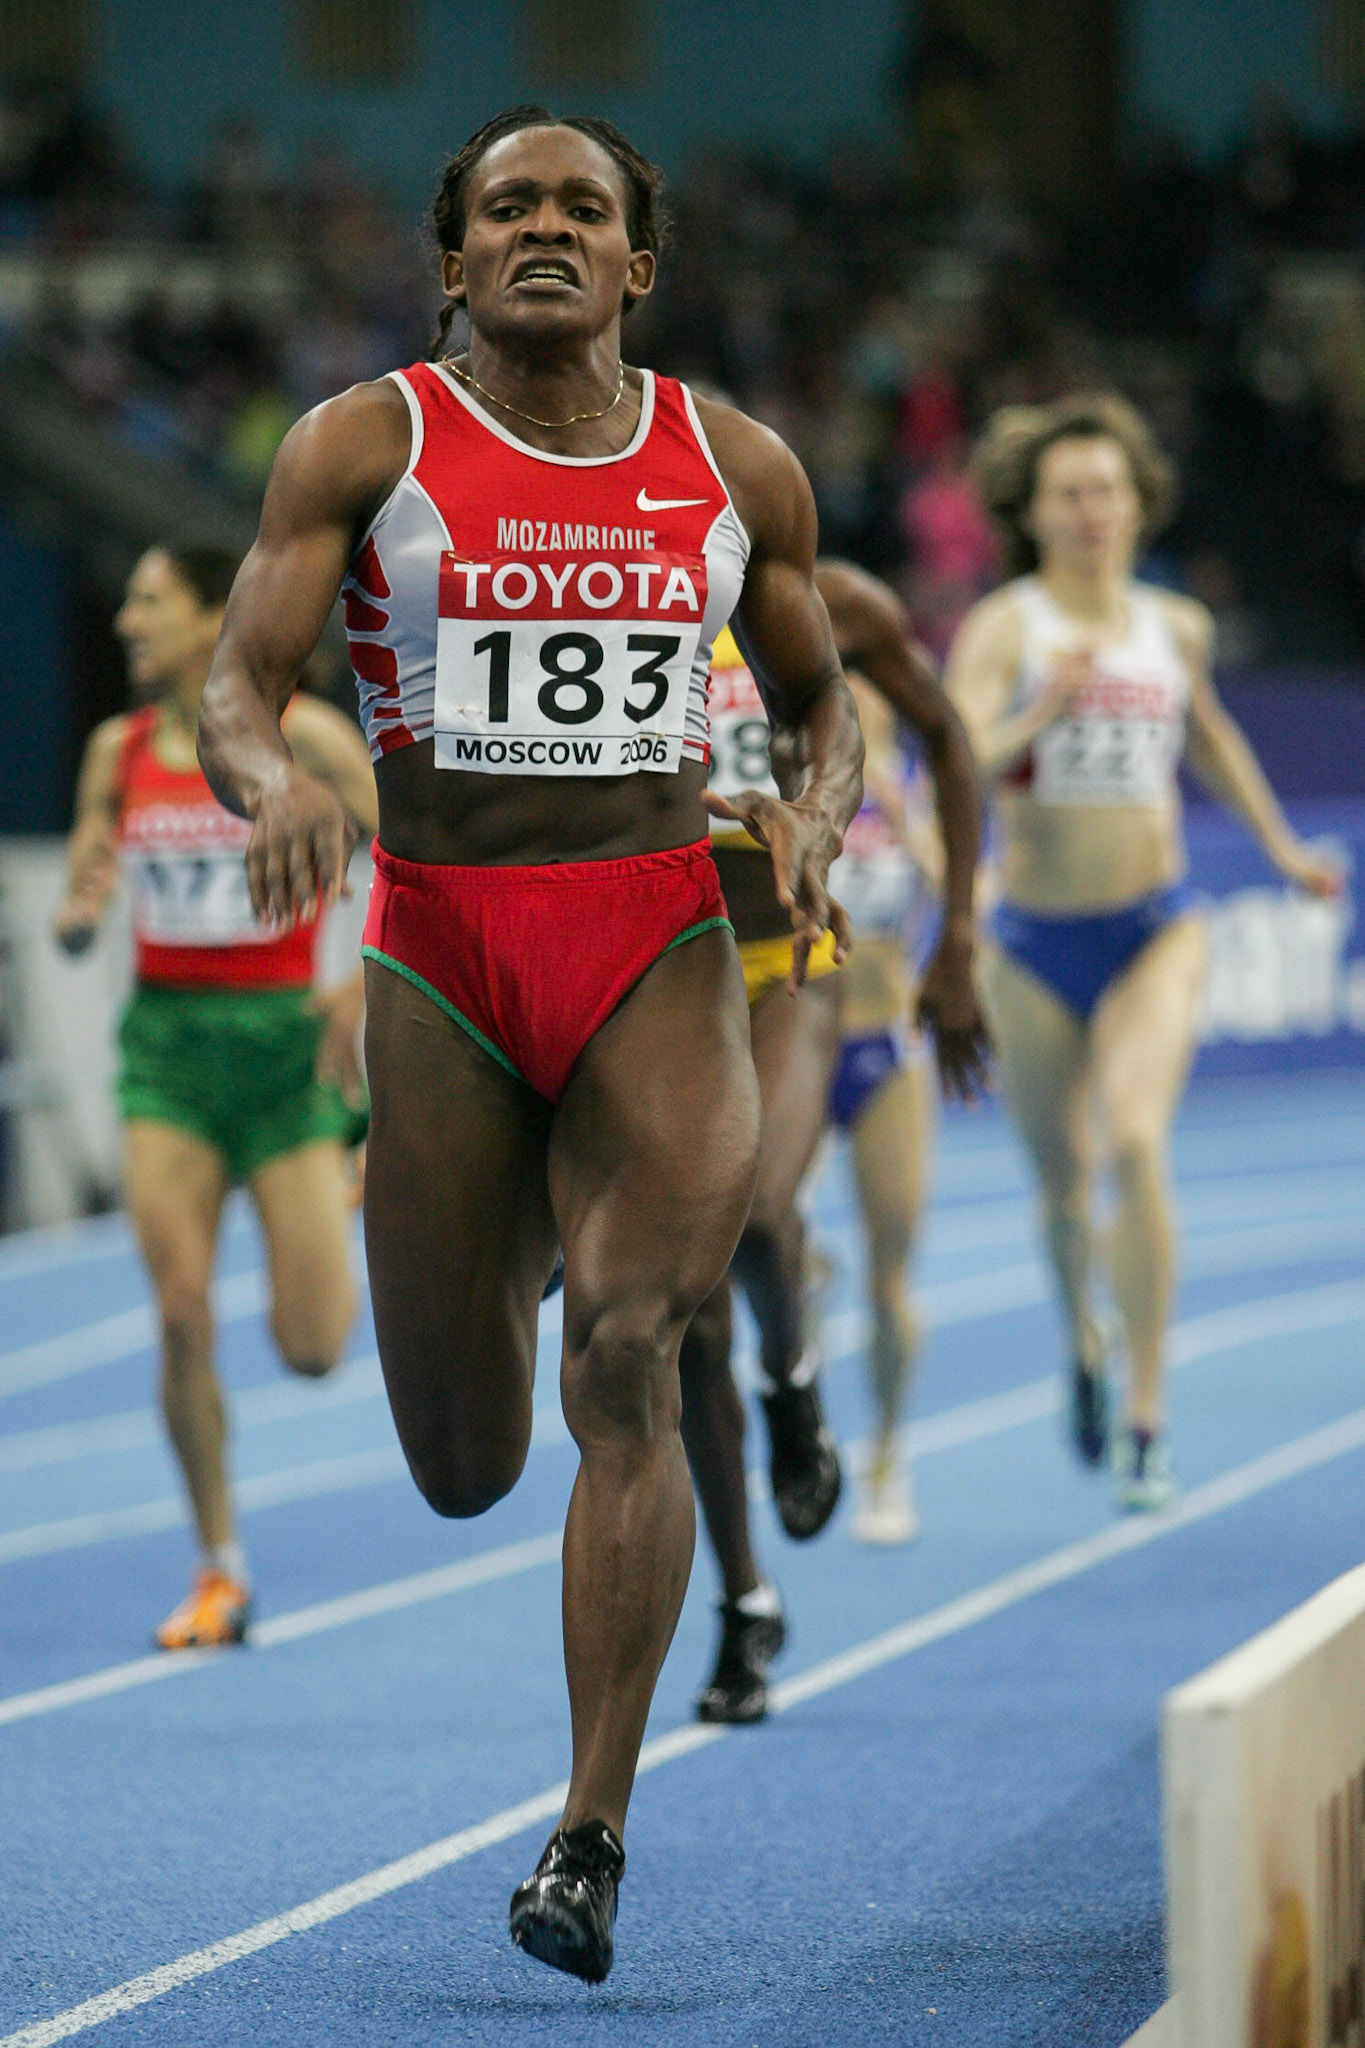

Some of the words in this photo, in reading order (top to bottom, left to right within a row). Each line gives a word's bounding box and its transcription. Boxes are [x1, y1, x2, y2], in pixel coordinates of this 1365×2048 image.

[453, 561, 699, 612] TOYOTA
[473, 631, 681, 725] 183
[456, 739, 603, 765] MOSCOW
[620, 737, 668, 765] 2006
